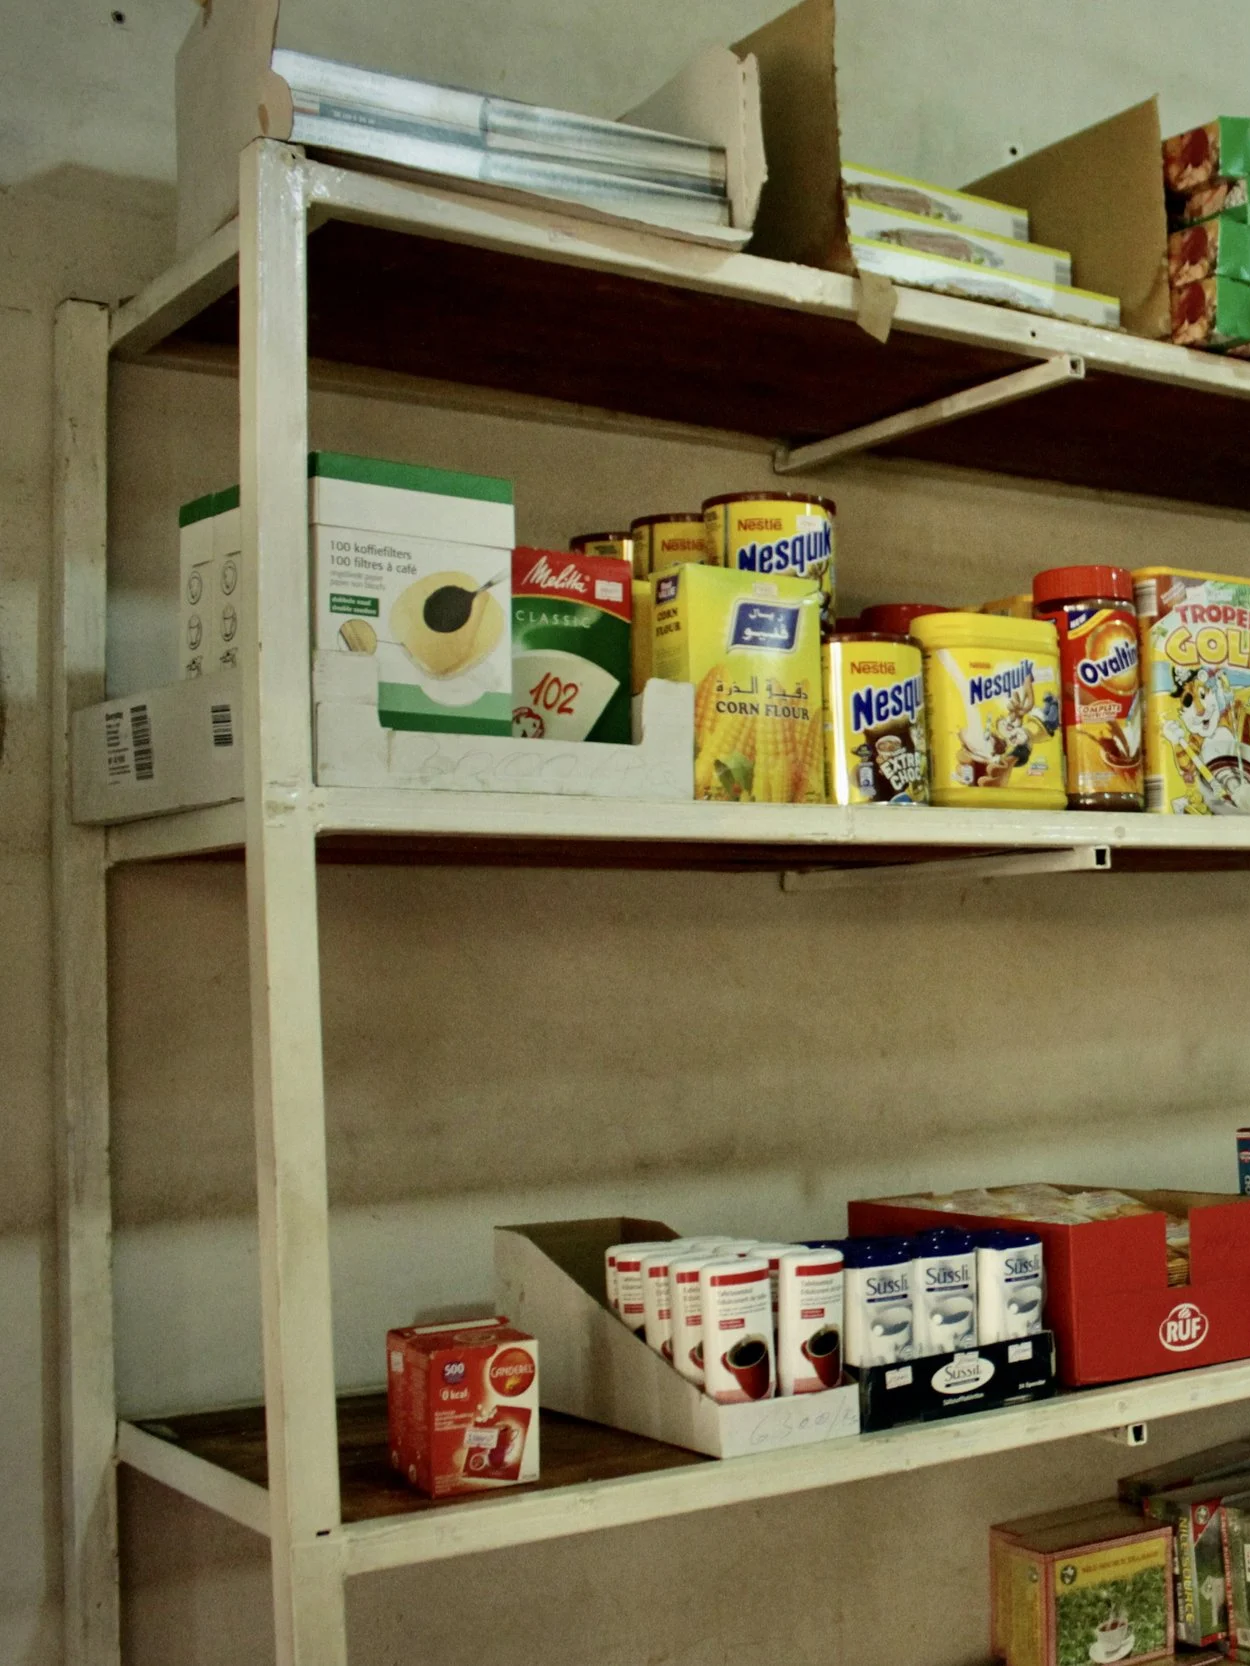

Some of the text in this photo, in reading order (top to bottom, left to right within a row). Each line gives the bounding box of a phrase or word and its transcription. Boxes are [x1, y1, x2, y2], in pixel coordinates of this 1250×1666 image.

[331, 540, 412, 560] 100 koffiefilters
[738, 520, 832, 574] Nesquik
[331, 555, 351, 567] 100
[354, 557, 384, 571] filtres
[396, 564, 417, 576] café
[521, 555, 588, 593] Melitta
[515, 610, 591, 629] CLASSIC
[657, 608, 678, 622] CORN
[970, 659, 1035, 705] Nesquik
[529, 672, 580, 715] 102
[716, 700, 810, 721] CORN FLOUR
[880, 752, 921, 779] EXTRA
[1166, 1319, 1201, 1343] RUF
[445, 1362, 465, 1377] 500
